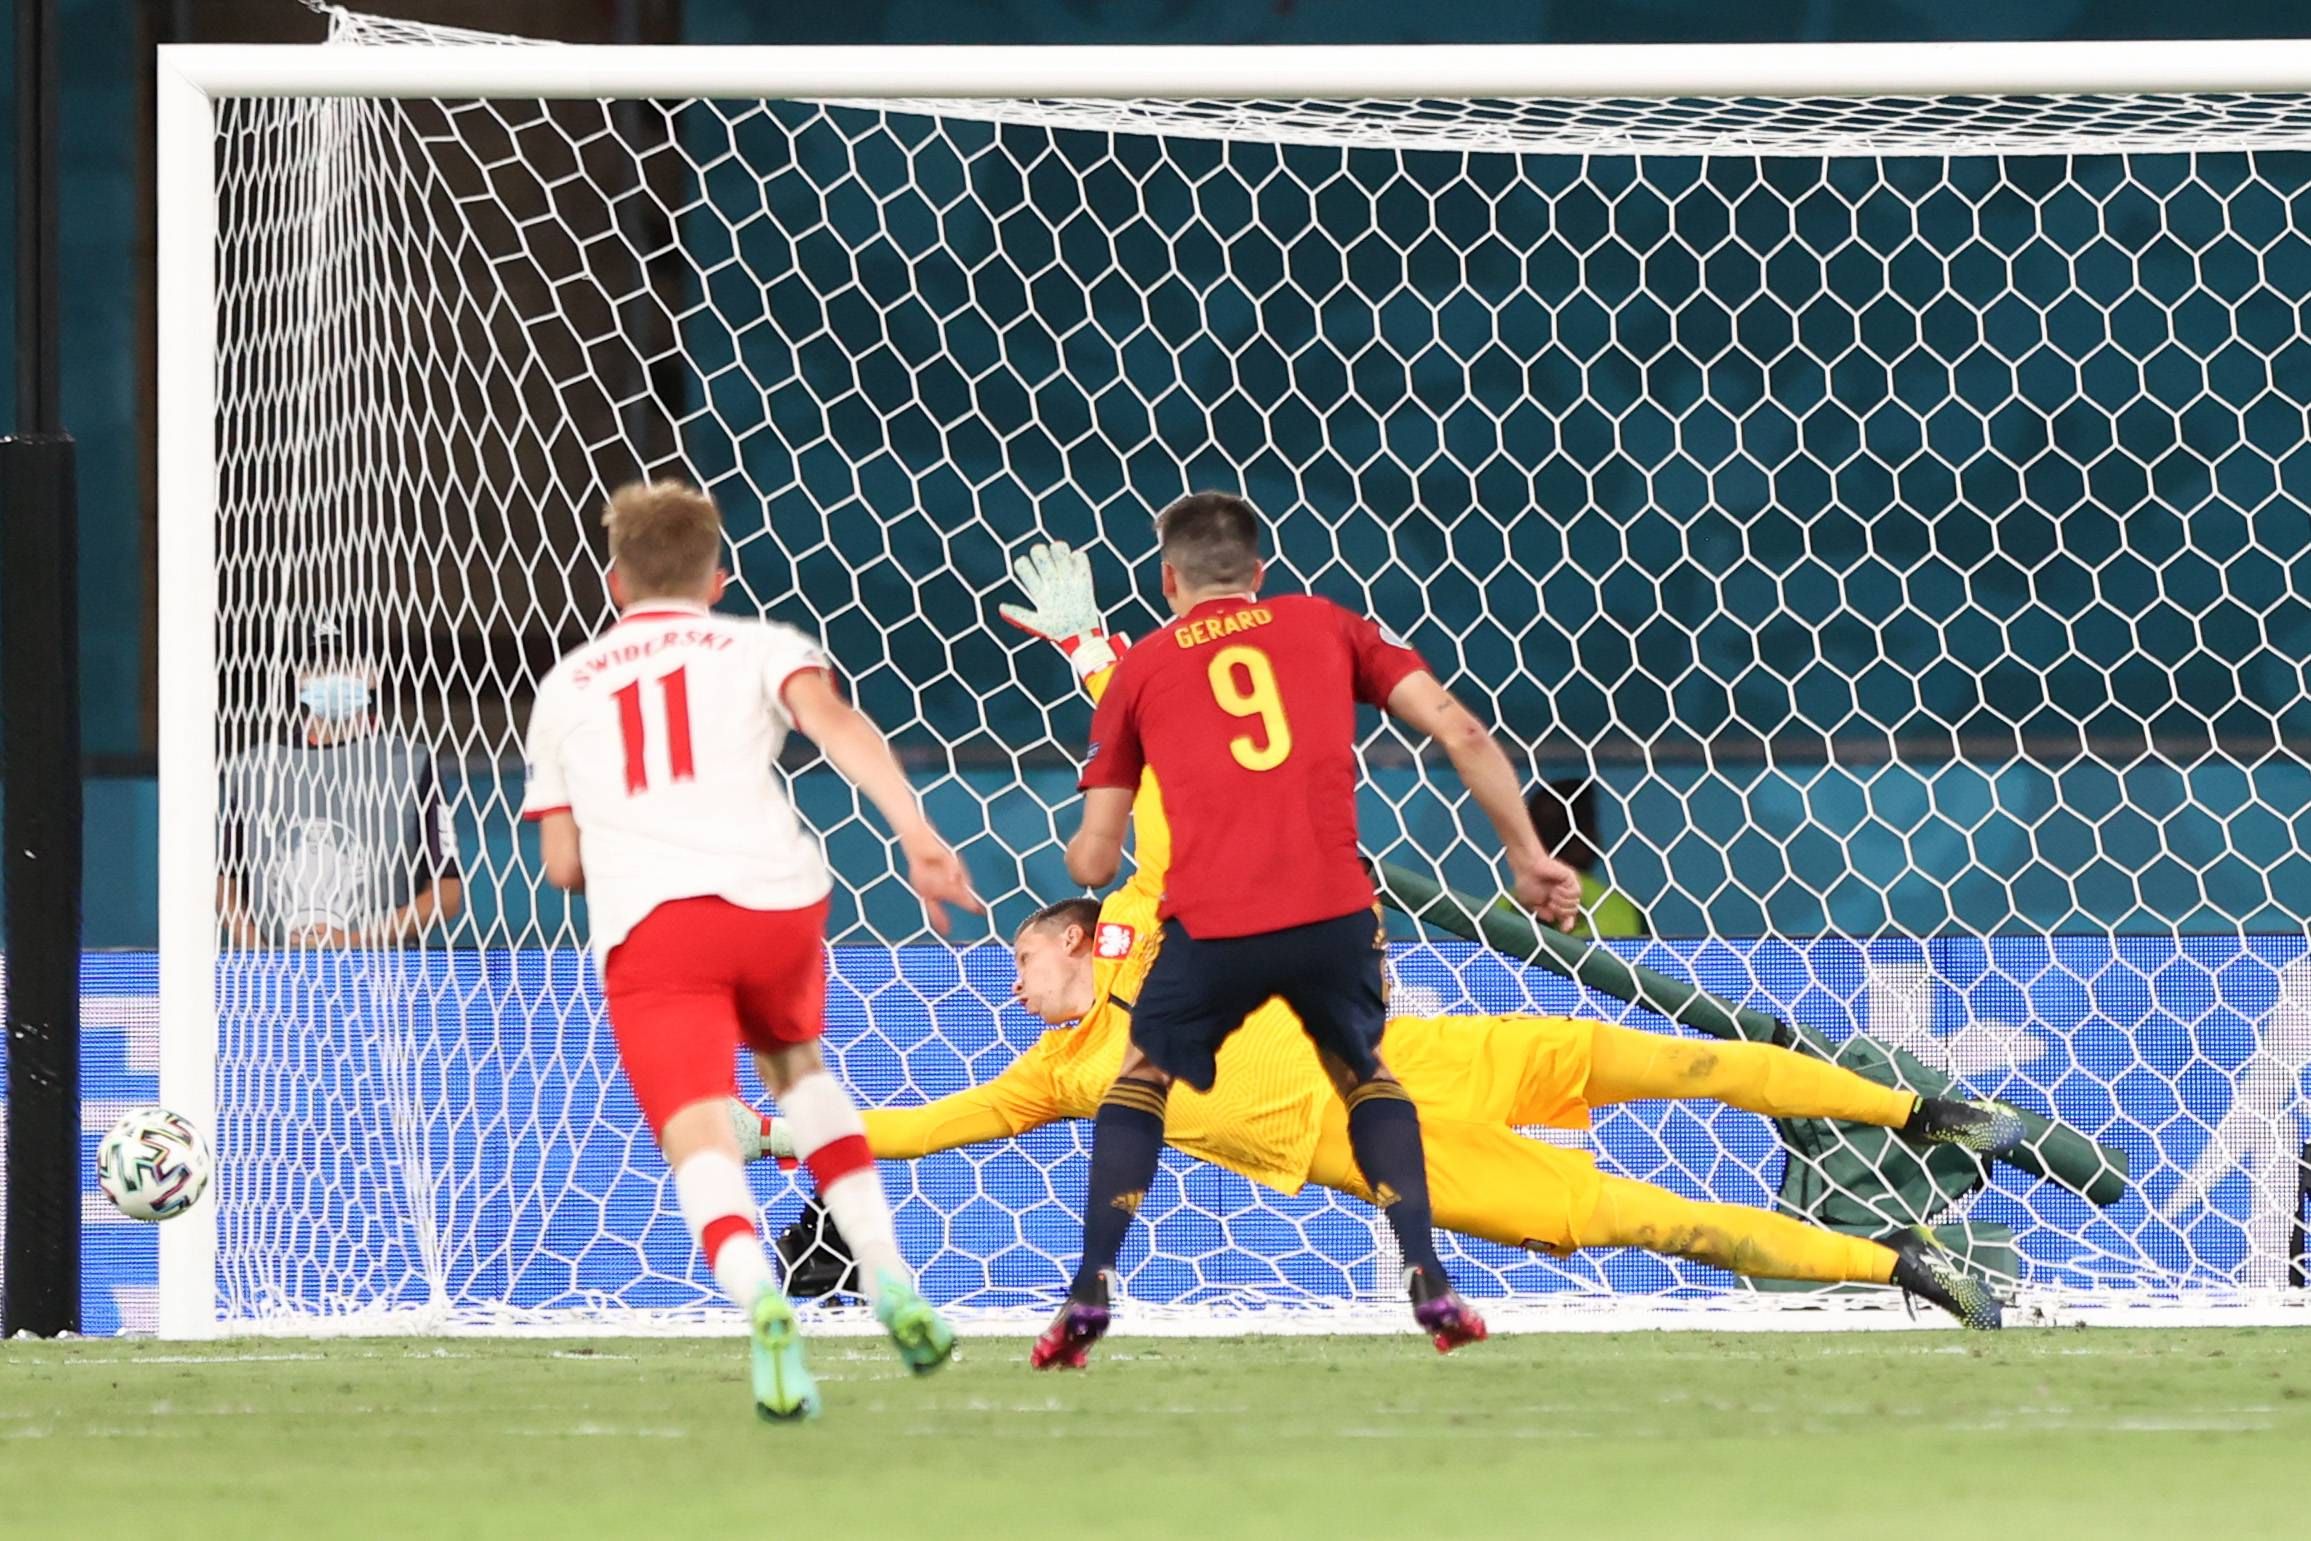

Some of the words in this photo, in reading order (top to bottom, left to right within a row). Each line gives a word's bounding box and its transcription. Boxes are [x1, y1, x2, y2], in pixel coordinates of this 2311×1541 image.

[1175, 609, 1272, 648] GERARD
[611, 664, 695, 797] 11
[1208, 646, 1291, 771] 9
